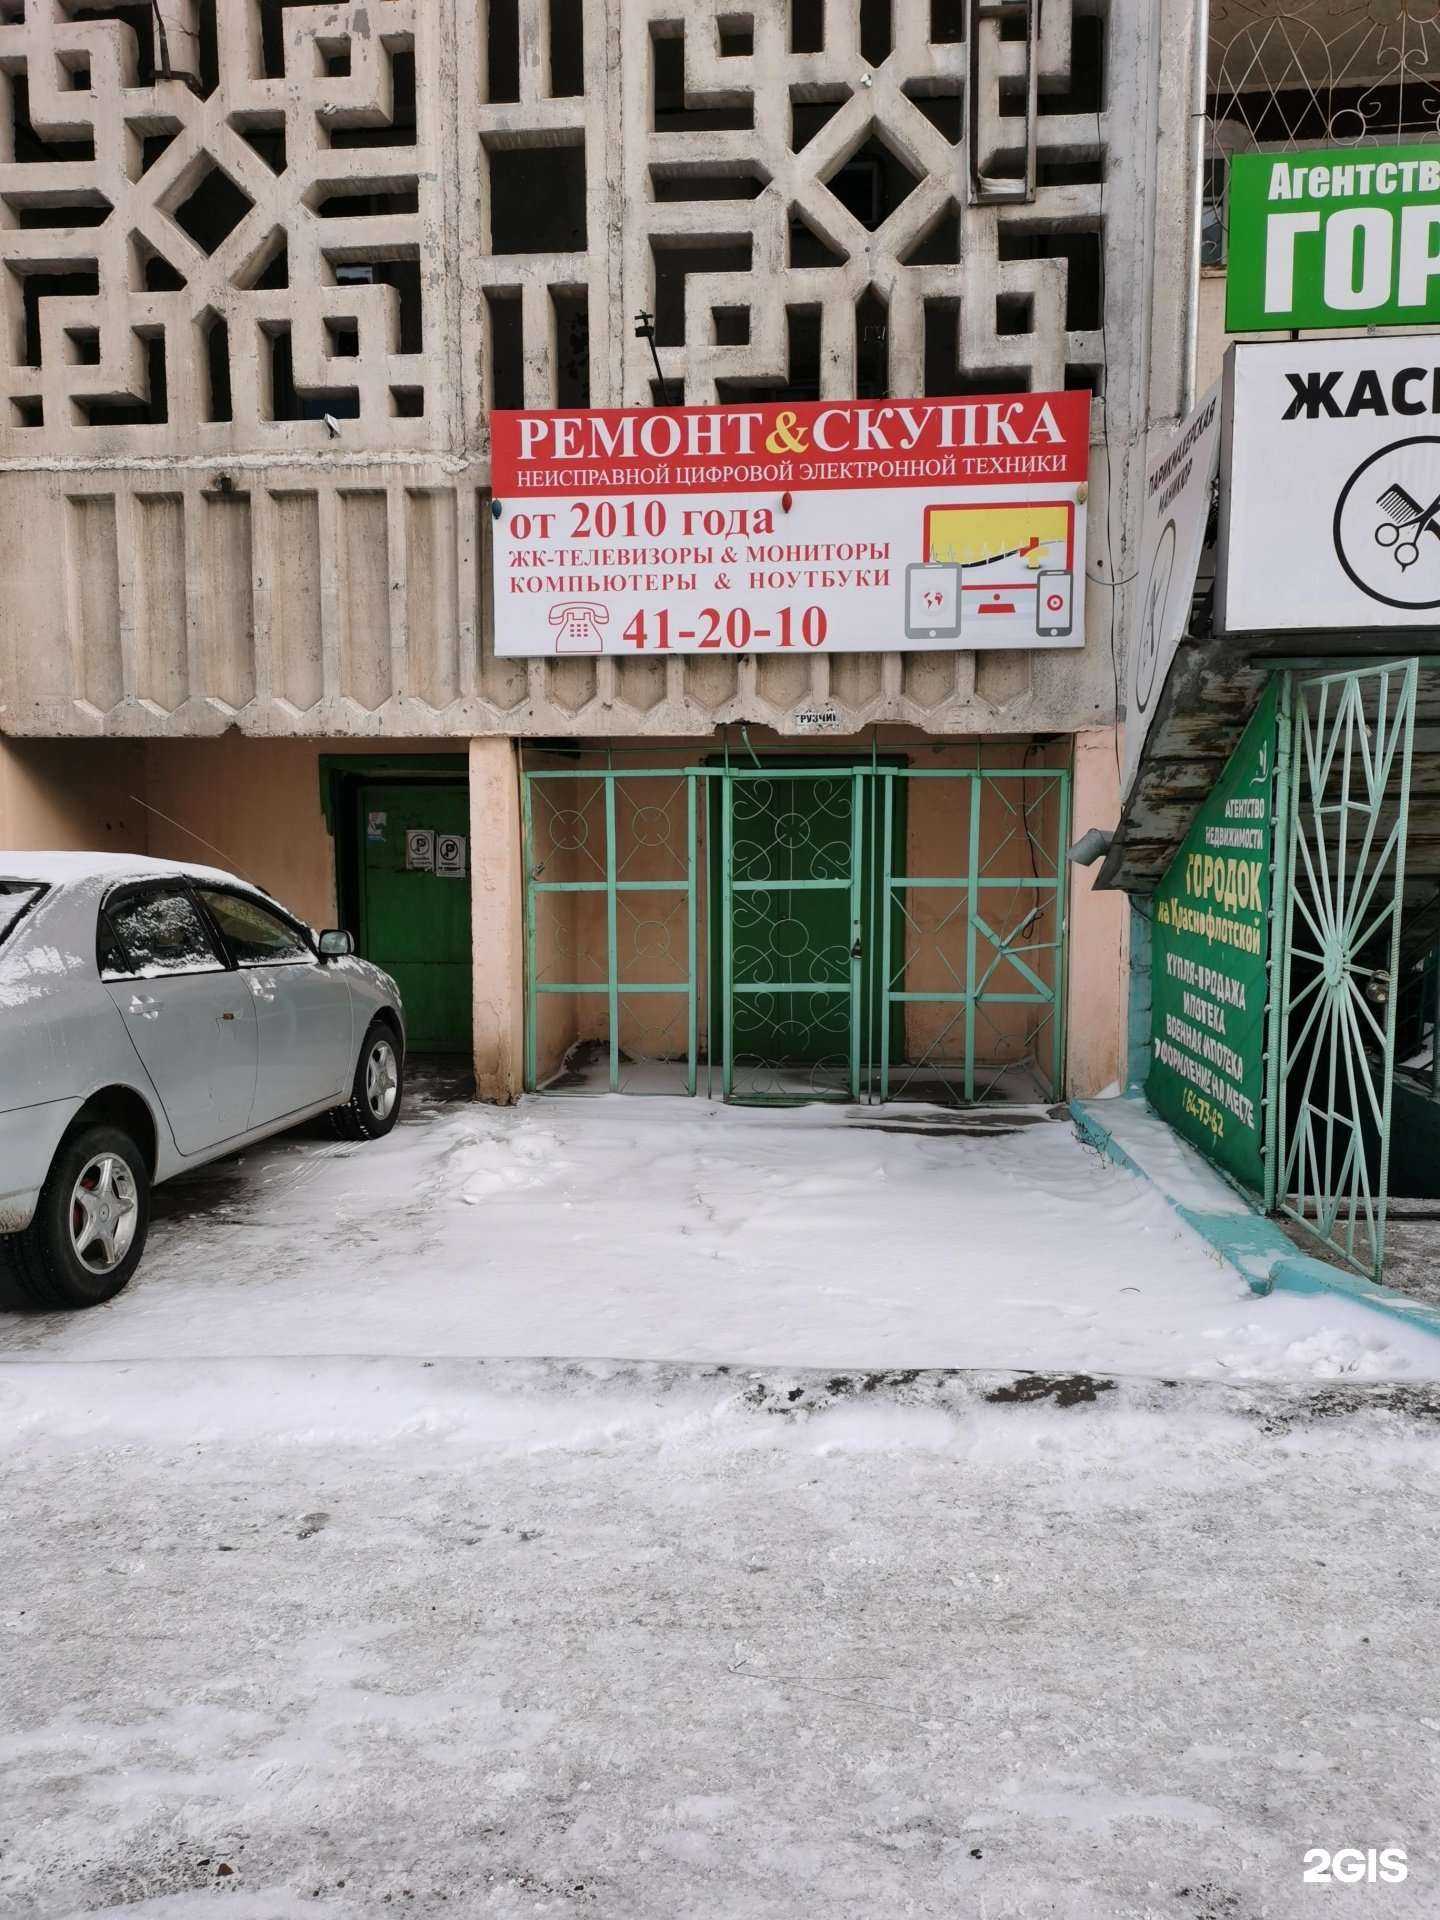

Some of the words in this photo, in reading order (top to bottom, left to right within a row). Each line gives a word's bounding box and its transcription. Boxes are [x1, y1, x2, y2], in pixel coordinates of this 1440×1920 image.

[1268, 160, 1440, 200] Агентств
[1264, 204, 1440, 313] ГОР
[1281, 366, 1440, 420] ЖАС
[517, 464, 669, 488] НЕИСПРАВНОЙ
[676, 460, 794, 486] ЦИФРОВОЙ
[799, 454, 956, 480] ЭЛЕКТРОННОЙ
[962, 454, 1067, 475] ТЕХНИКИ
[510, 513, 556, 539] от
[570, 500, 667, 538] 2010
[681, 506, 775, 538] года
[508, 546, 714, 568] ЖК-ТЕЛЕВИЗОРЫ
[720, 545, 738, 564] &
[745, 541, 891, 563] МОНИТОРЫ
[510, 572, 697, 593] КОМПЬЮТЕРЫ
[714, 571, 732, 590] &
[749, 568, 891, 589] НОУТБУКИ
[622, 605, 828, 649] 41-20-10
[1225, 798, 1265, 819] АГЕНТСТВО
[1205, 826, 1264, 849] НЕДВИЖИМОСТИ
[1186, 853, 1263, 914] ГОРОДОК
[1158, 901, 1170, 924] на
[1171, 897, 1260, 955] Краснофлотской
[1166, 952, 1246, 1011] КУПЛЯ-ПРОДАЖА
[1183, 991, 1226, 1036] ИПОТЕКА
[1166, 1012, 1203, 1055] ВОЕННАЯ
[1203, 1034, 1243, 1084] ИПОТЕКА
[1225, 1083, 1255, 1130] МЕСТЕ
